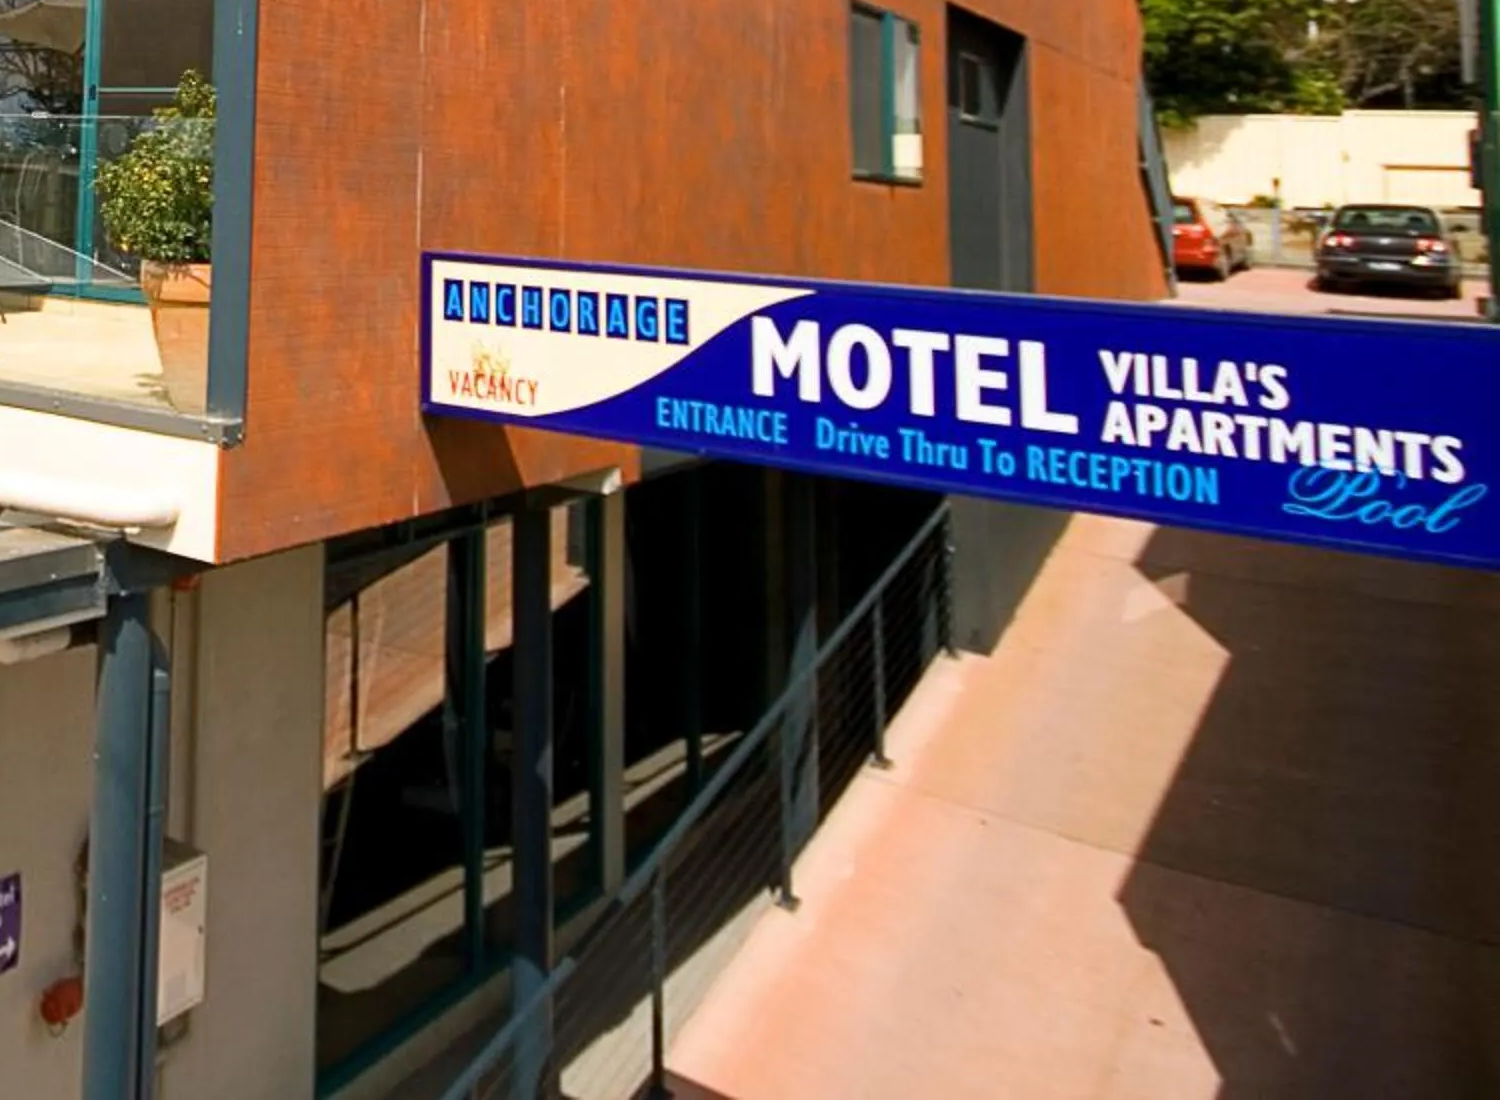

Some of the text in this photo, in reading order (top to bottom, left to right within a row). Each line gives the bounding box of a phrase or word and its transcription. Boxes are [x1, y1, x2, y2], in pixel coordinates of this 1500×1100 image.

[444, 280, 688, 343] ANCHORAGE
[449, 370, 539, 406] VACANCY
[750, 315, 1080, 435] MOTEL
[1098, 349, 1290, 410] VILLA'S
[655, 396, 1219, 505] ENTRANCE Drive Thru To RECEPTION
[1101, 401, 1466, 485] APARTMENTS
[1282, 458, 1489, 534] Pool
